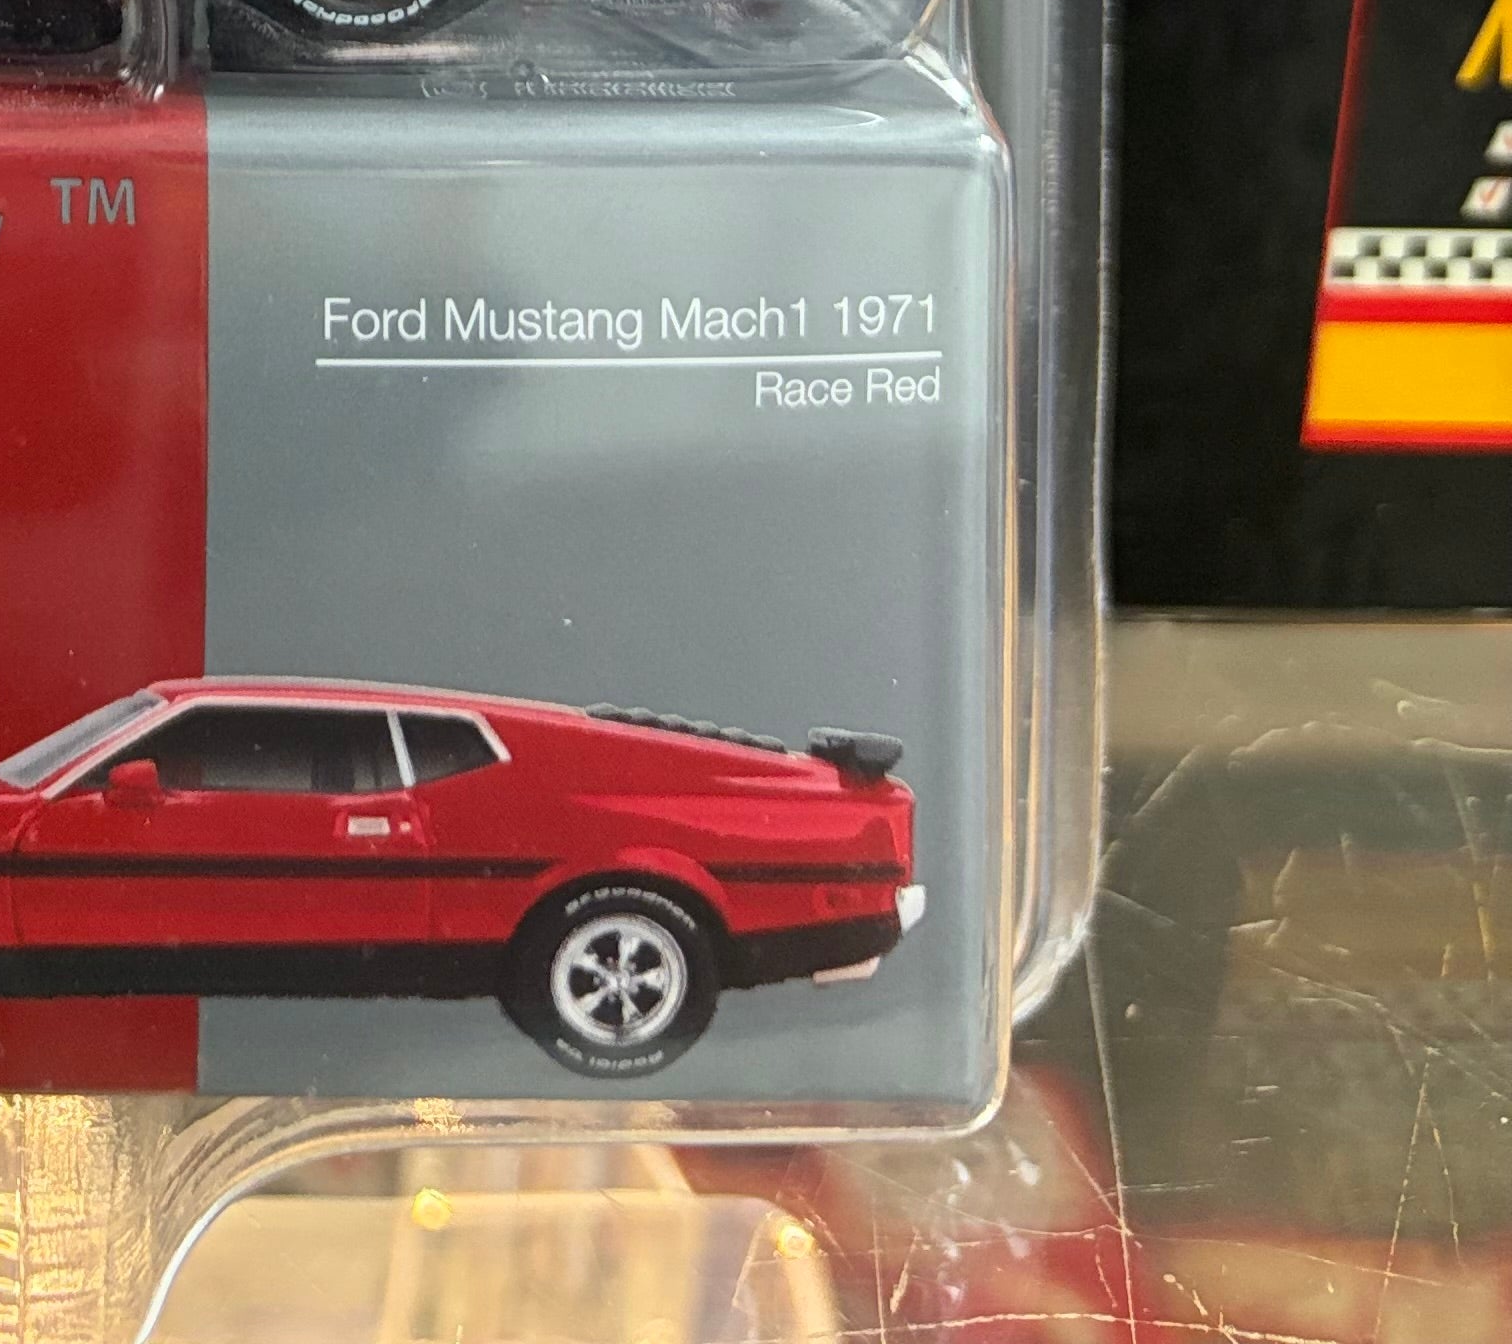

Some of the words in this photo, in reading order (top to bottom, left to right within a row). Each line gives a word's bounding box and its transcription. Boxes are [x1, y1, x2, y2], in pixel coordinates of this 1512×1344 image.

[49, 177, 136, 225] TM
[322, 296, 426, 342] Ford
[443, 296, 643, 351] Mustang
[660, 295, 808, 341] Mach1
[832, 292, 935, 337] 1971
[754, 368, 854, 408] Race
[865, 364, 941, 405] Red
